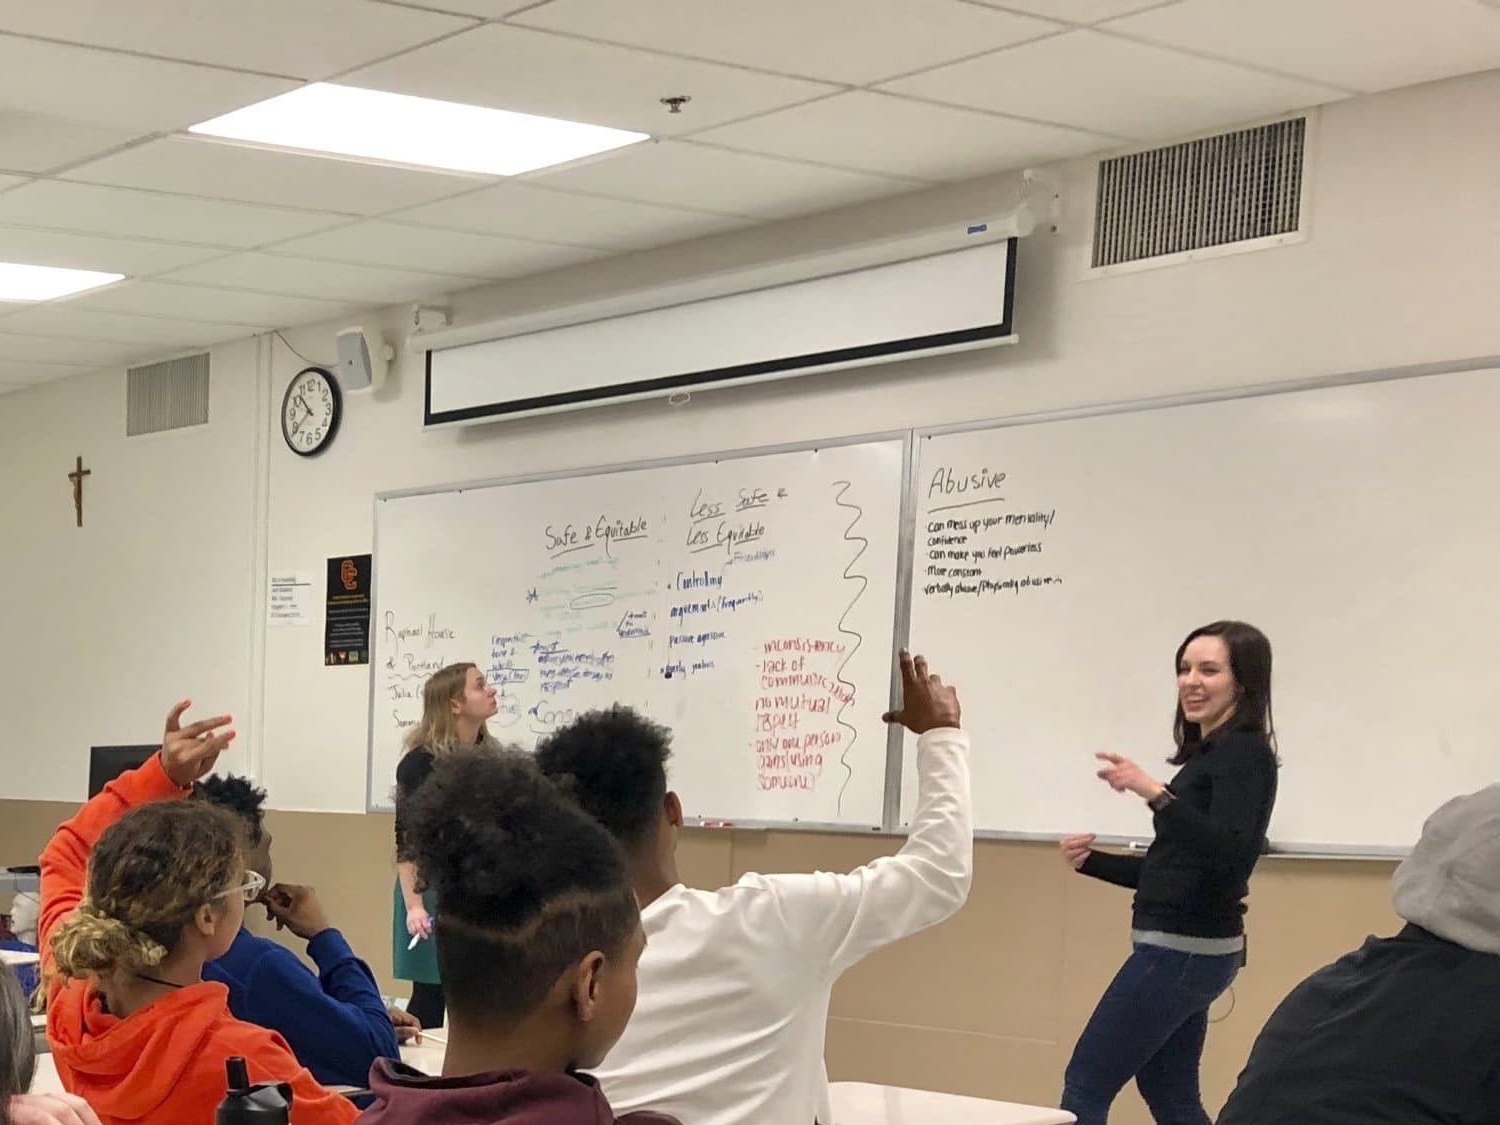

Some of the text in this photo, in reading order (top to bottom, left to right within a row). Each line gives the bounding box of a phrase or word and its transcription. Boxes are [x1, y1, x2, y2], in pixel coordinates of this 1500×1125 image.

[299, 430, 305, 443] 7
[306, 432, 313, 445] 6
[315, 427, 322, 441] 5
[928, 467, 1006, 499] Abusive
[690, 488, 724, 518] Less
[545, 525, 579, 550] Safe
[595, 515, 647, 559] Equitable
